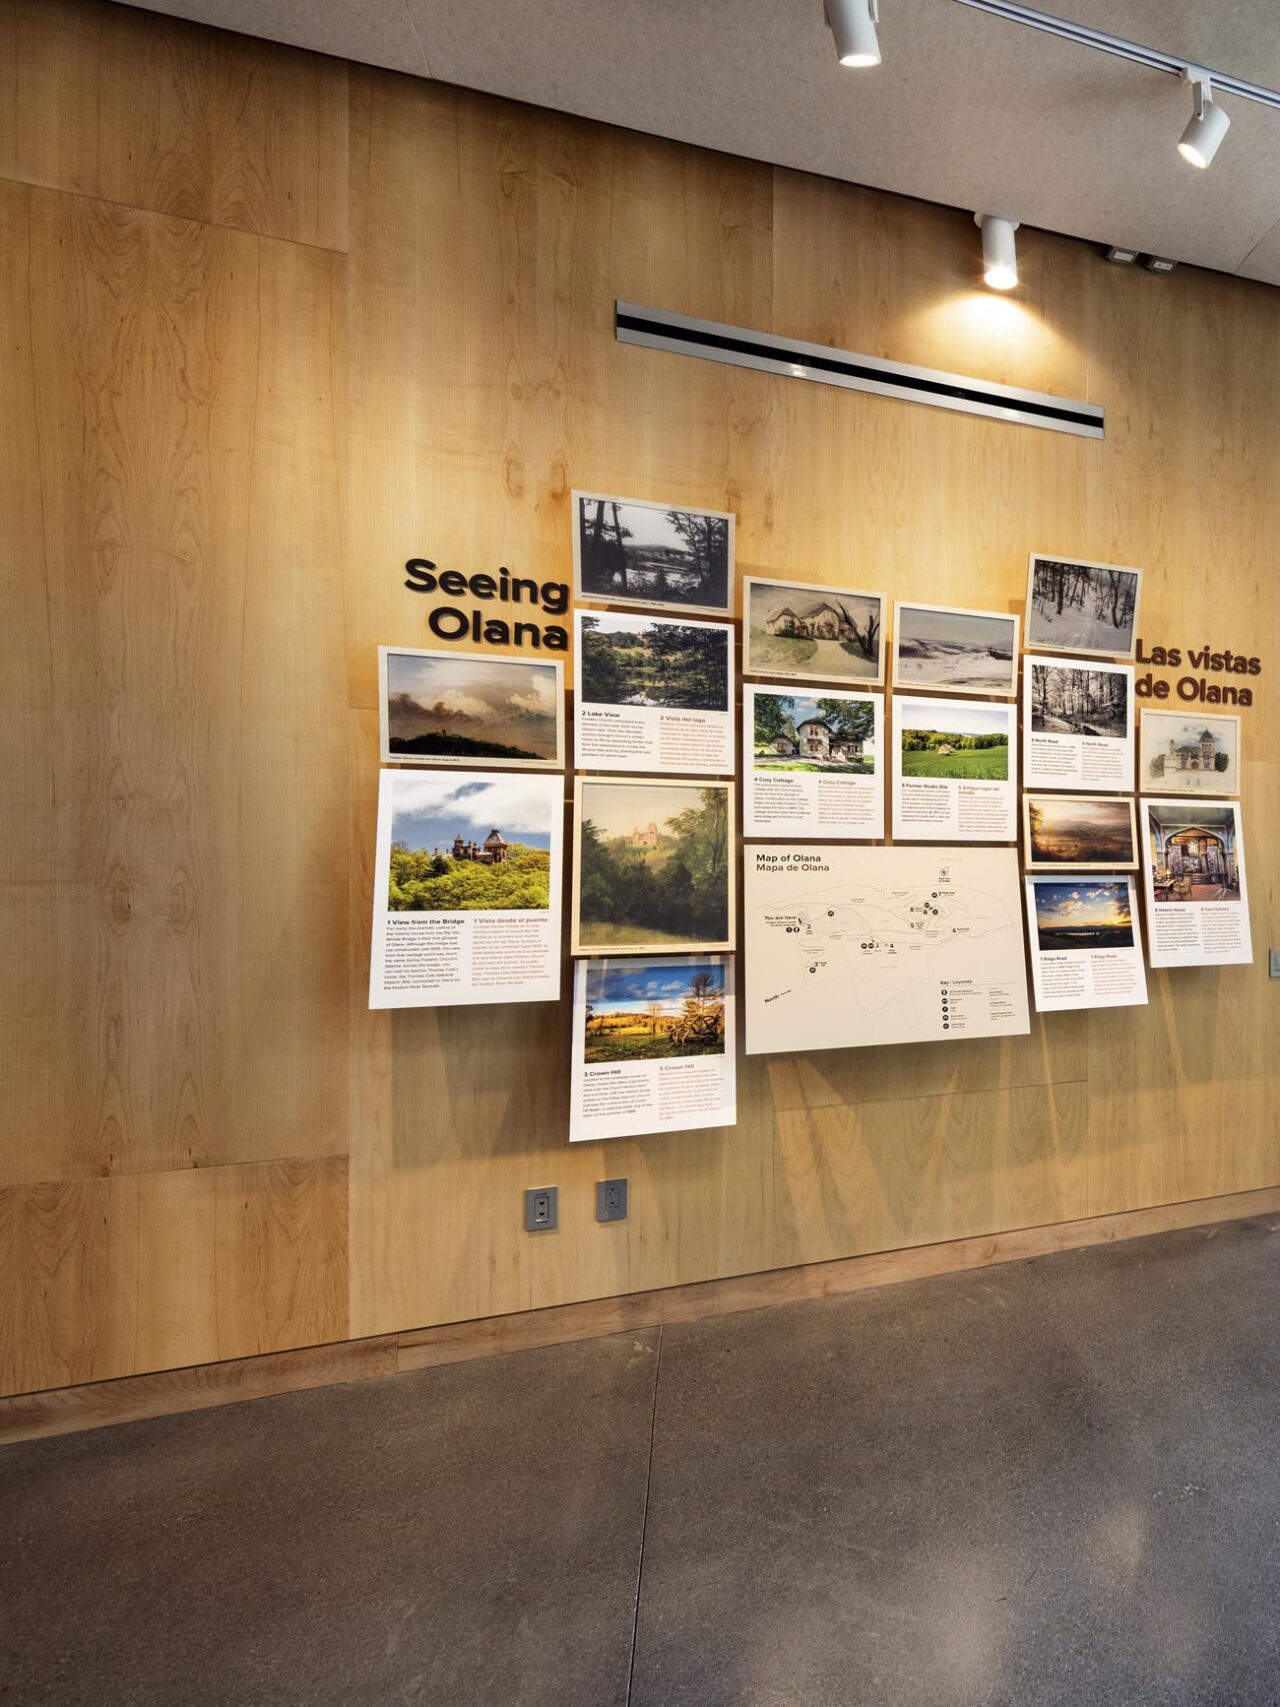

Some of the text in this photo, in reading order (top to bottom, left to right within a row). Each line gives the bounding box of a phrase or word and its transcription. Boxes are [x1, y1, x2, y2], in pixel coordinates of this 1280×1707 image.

[404, 558, 570, 615] Seeing
[428, 606, 568, 651] Olana
[1135, 639, 1261, 675] Las vistas
[1135, 673, 1253, 706] de Olana
[757, 854, 821, 863] Map of Olana
[757, 863, 784, 873] Mapa
[801, 863, 829, 871] Olana
[764, 994, 779, 1004] North
